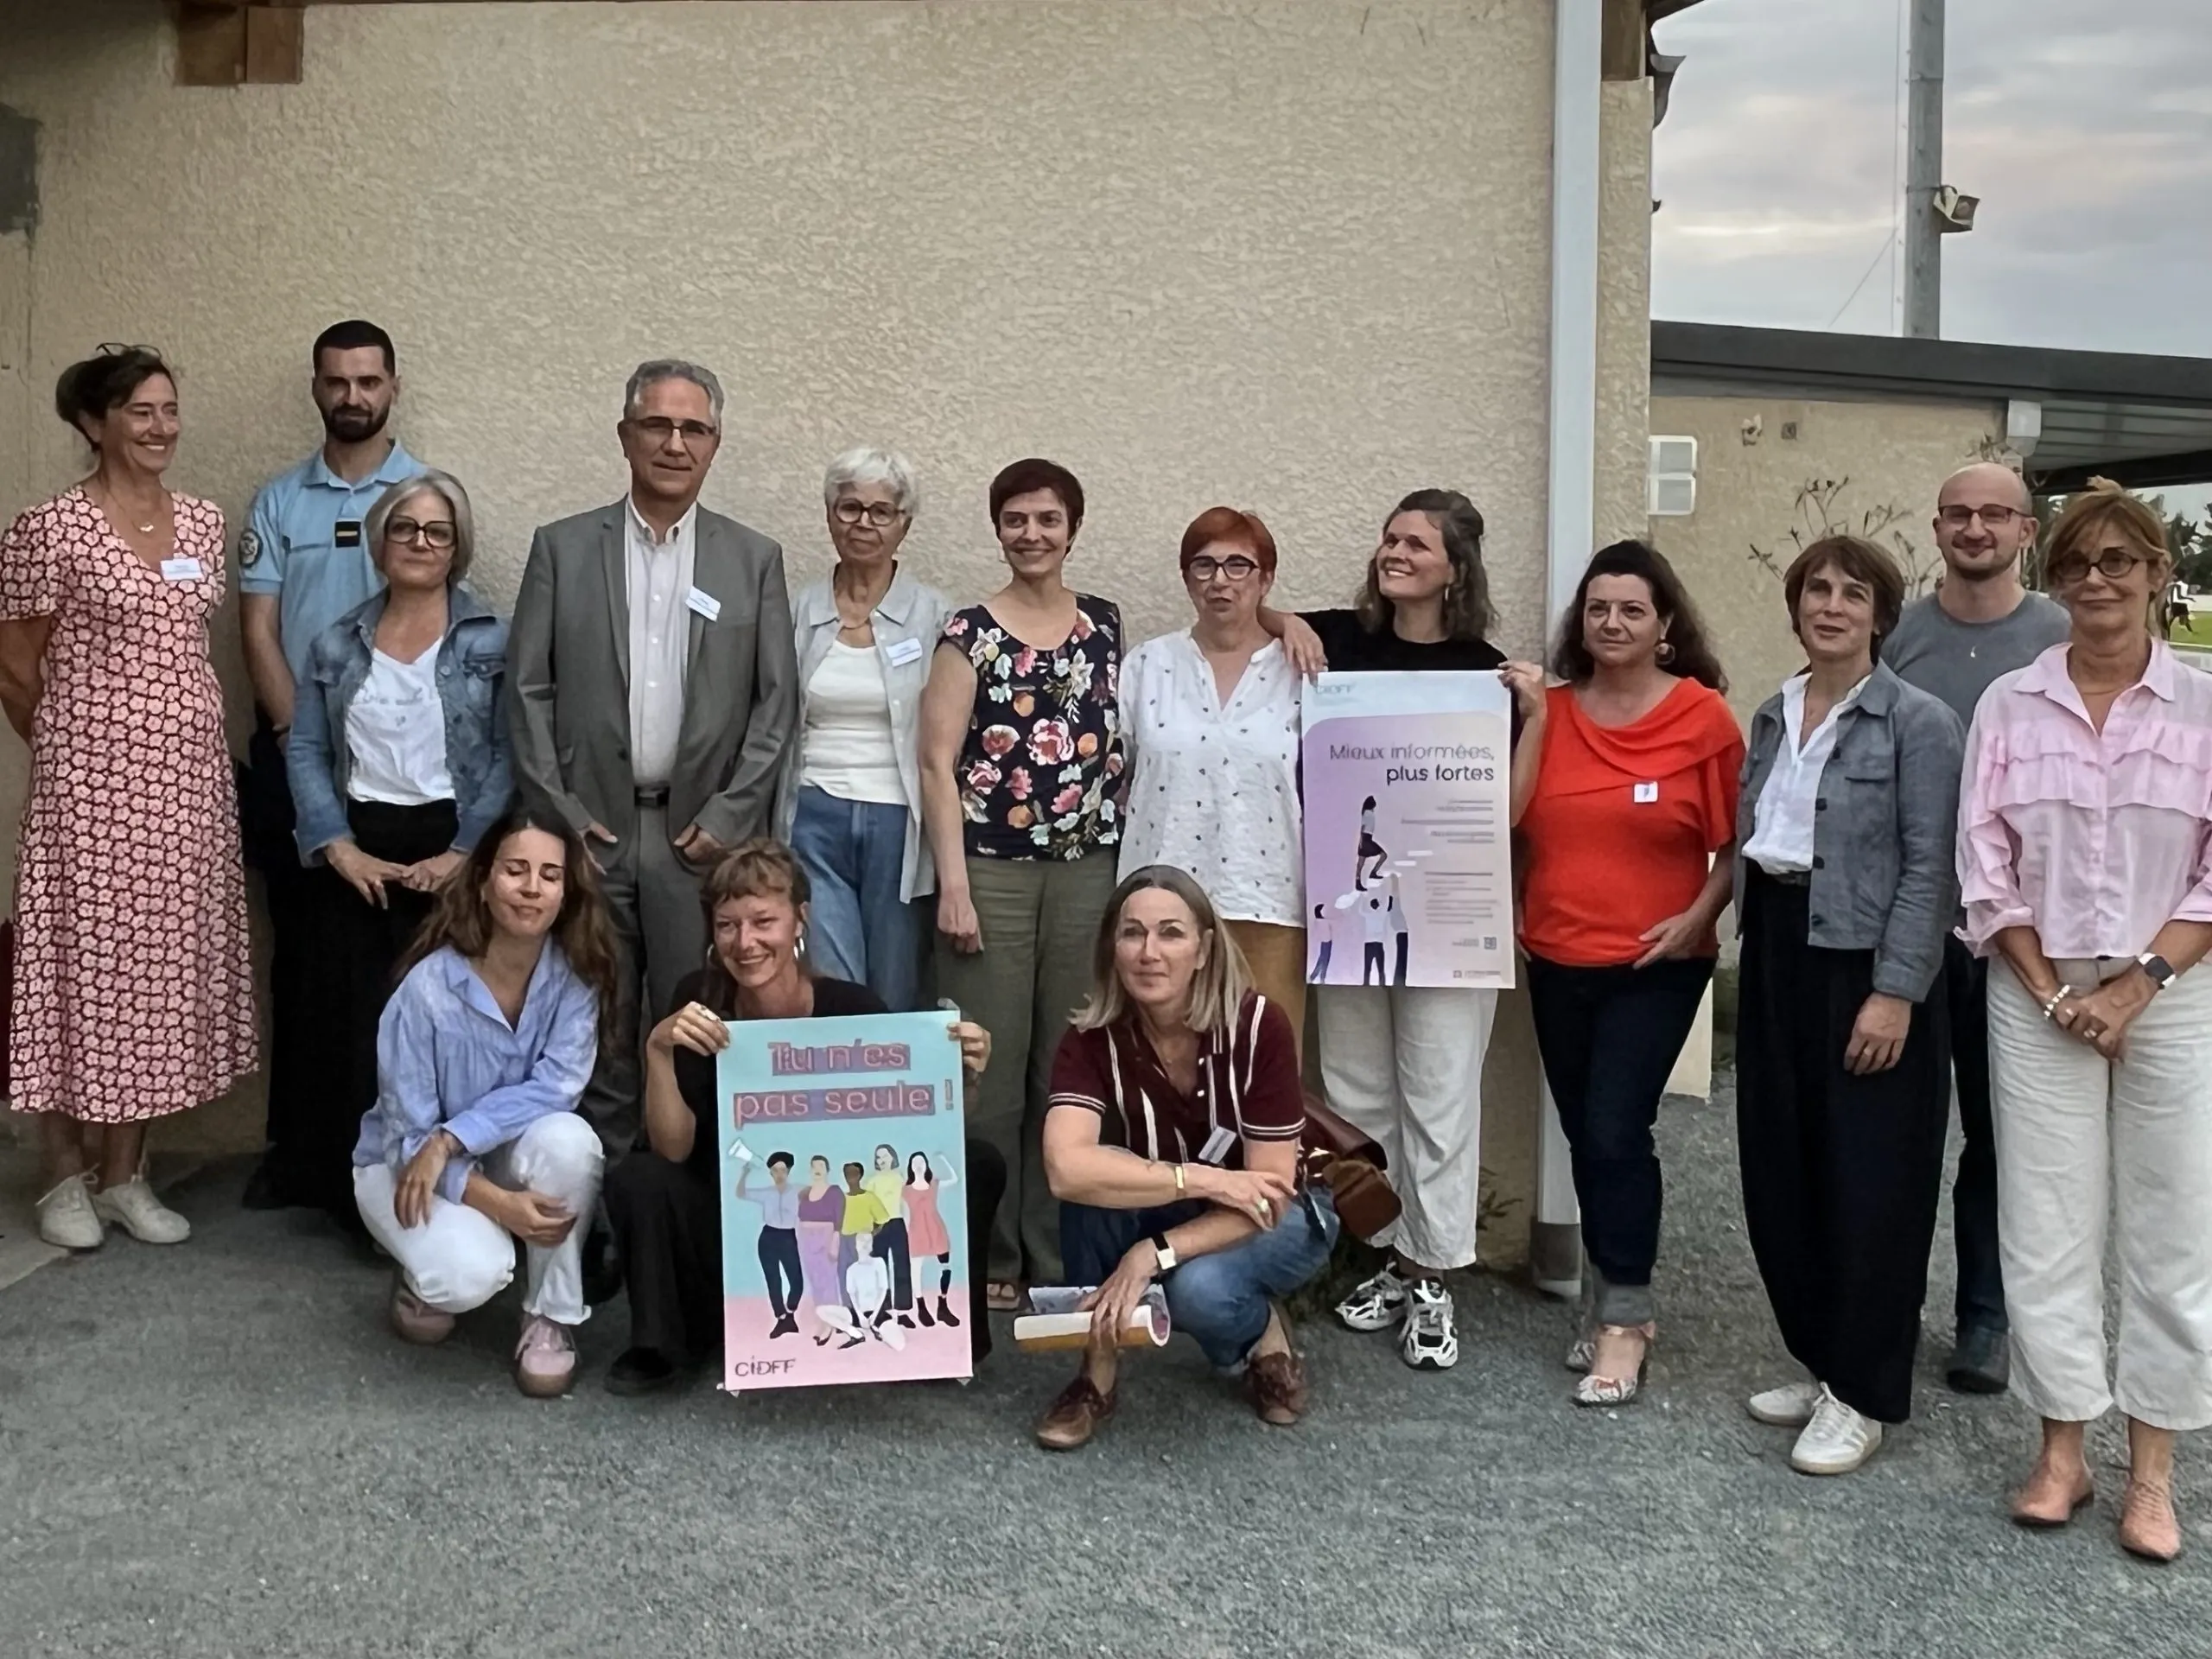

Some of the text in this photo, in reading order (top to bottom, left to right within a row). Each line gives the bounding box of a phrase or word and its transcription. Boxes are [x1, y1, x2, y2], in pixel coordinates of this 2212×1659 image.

[1330, 744, 1385, 760] Mieux
[1386, 764, 1495, 785] plus fortes
[768, 1039, 907, 1073] Tu n'es
[734, 1092, 810, 1130] pas
[823, 1079, 932, 1115] seule
